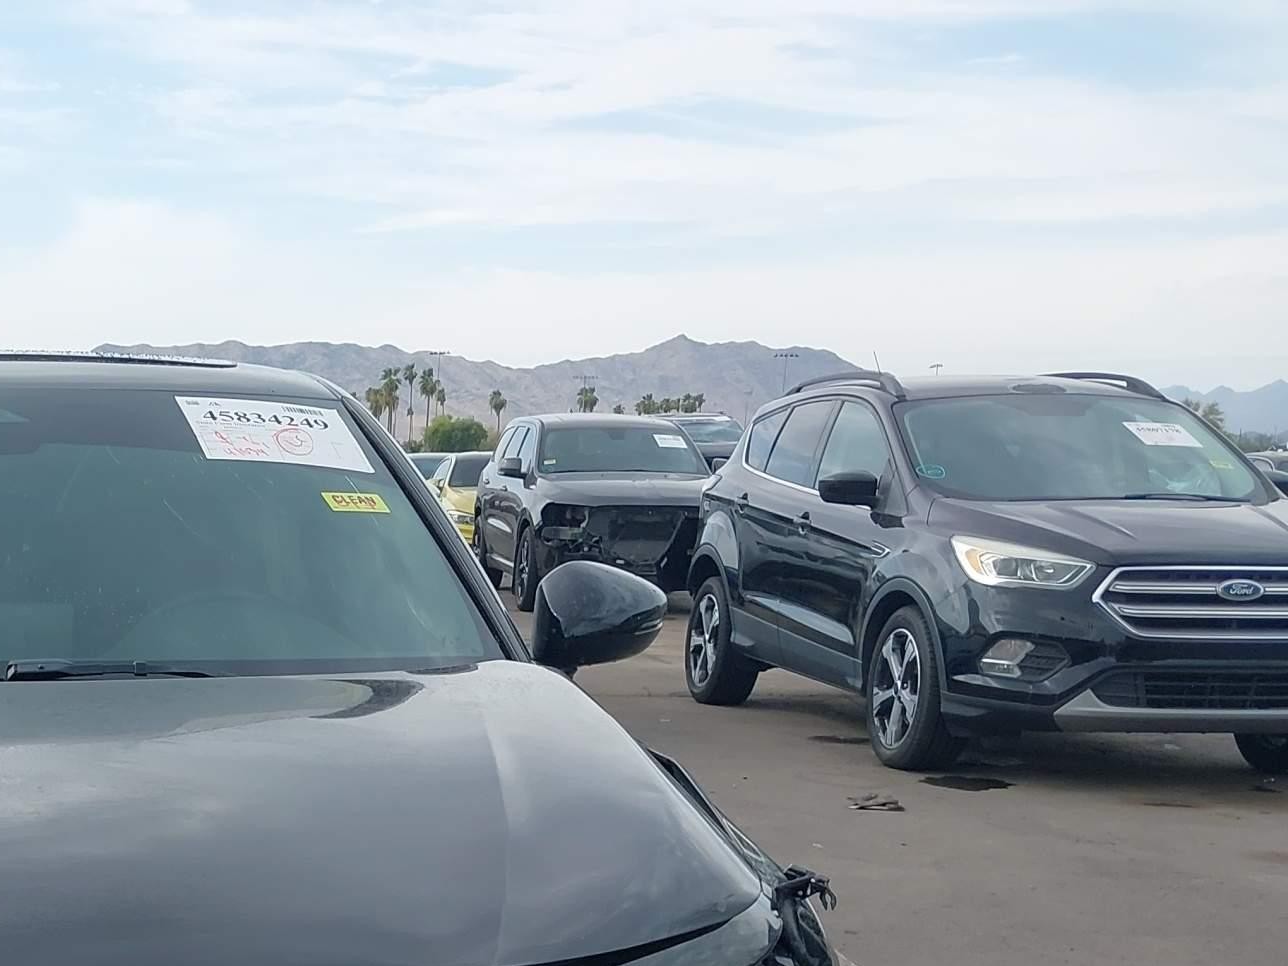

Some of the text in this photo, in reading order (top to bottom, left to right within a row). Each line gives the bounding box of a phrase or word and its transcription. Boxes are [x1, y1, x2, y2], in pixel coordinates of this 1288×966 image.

[203, 409, 329, 430] 45834249
[332, 495, 377, 507] CLEAN
[1229, 584, 1254, 595] Ford
